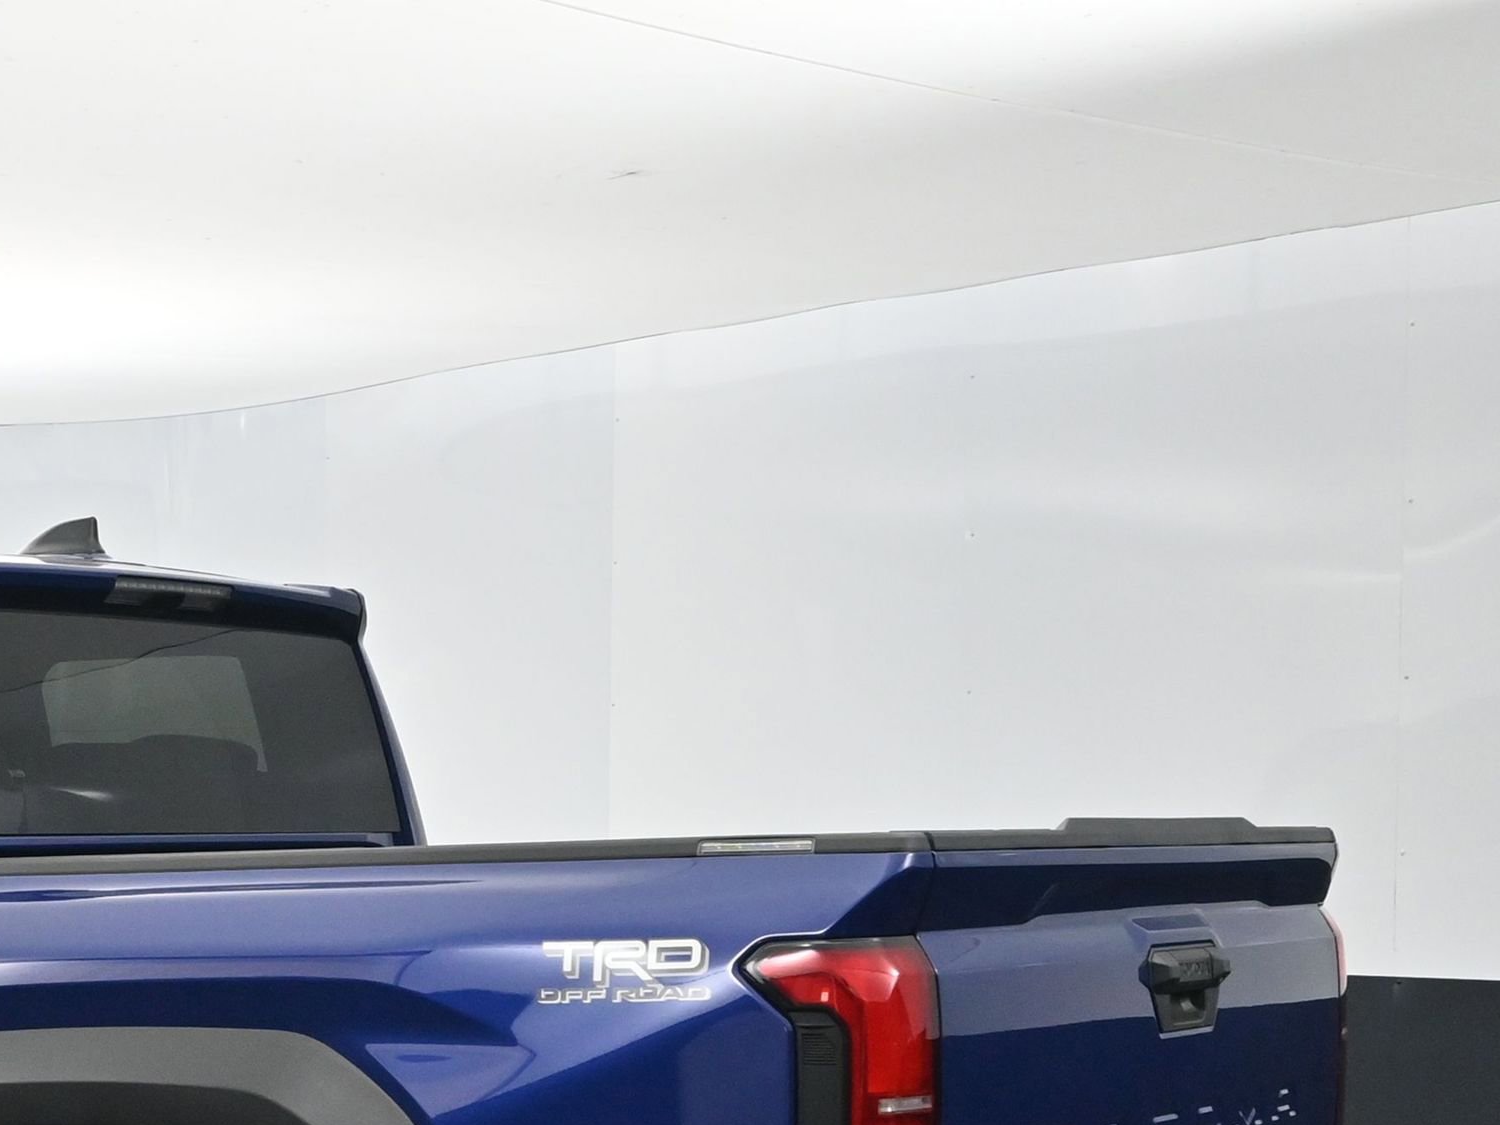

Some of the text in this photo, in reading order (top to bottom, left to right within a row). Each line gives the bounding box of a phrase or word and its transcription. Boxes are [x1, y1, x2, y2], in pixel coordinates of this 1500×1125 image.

[542, 938, 709, 989] TRD
[538, 986, 712, 1004] OFF ROAD
